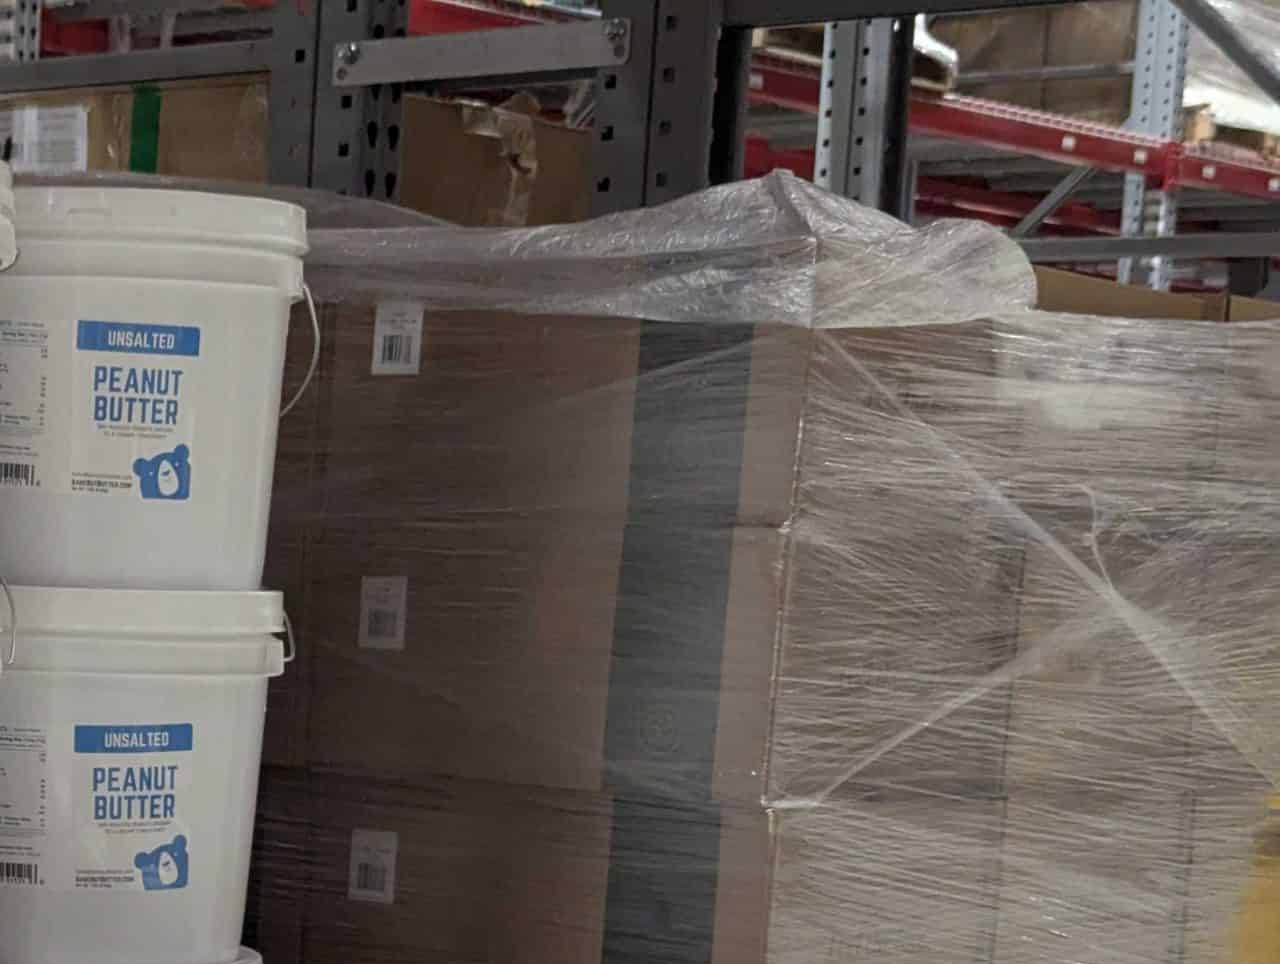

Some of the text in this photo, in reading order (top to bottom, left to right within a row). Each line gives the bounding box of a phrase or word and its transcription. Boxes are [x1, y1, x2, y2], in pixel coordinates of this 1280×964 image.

[108, 330, 175, 350] UNSALTED
[94, 366, 183, 396] PEANUT
[94, 396, 178, 424] BUTTER
[104, 732, 169, 748] UNSALTED
[92, 765, 178, 792] PEANUT
[94, 794, 176, 820] BUTTER
